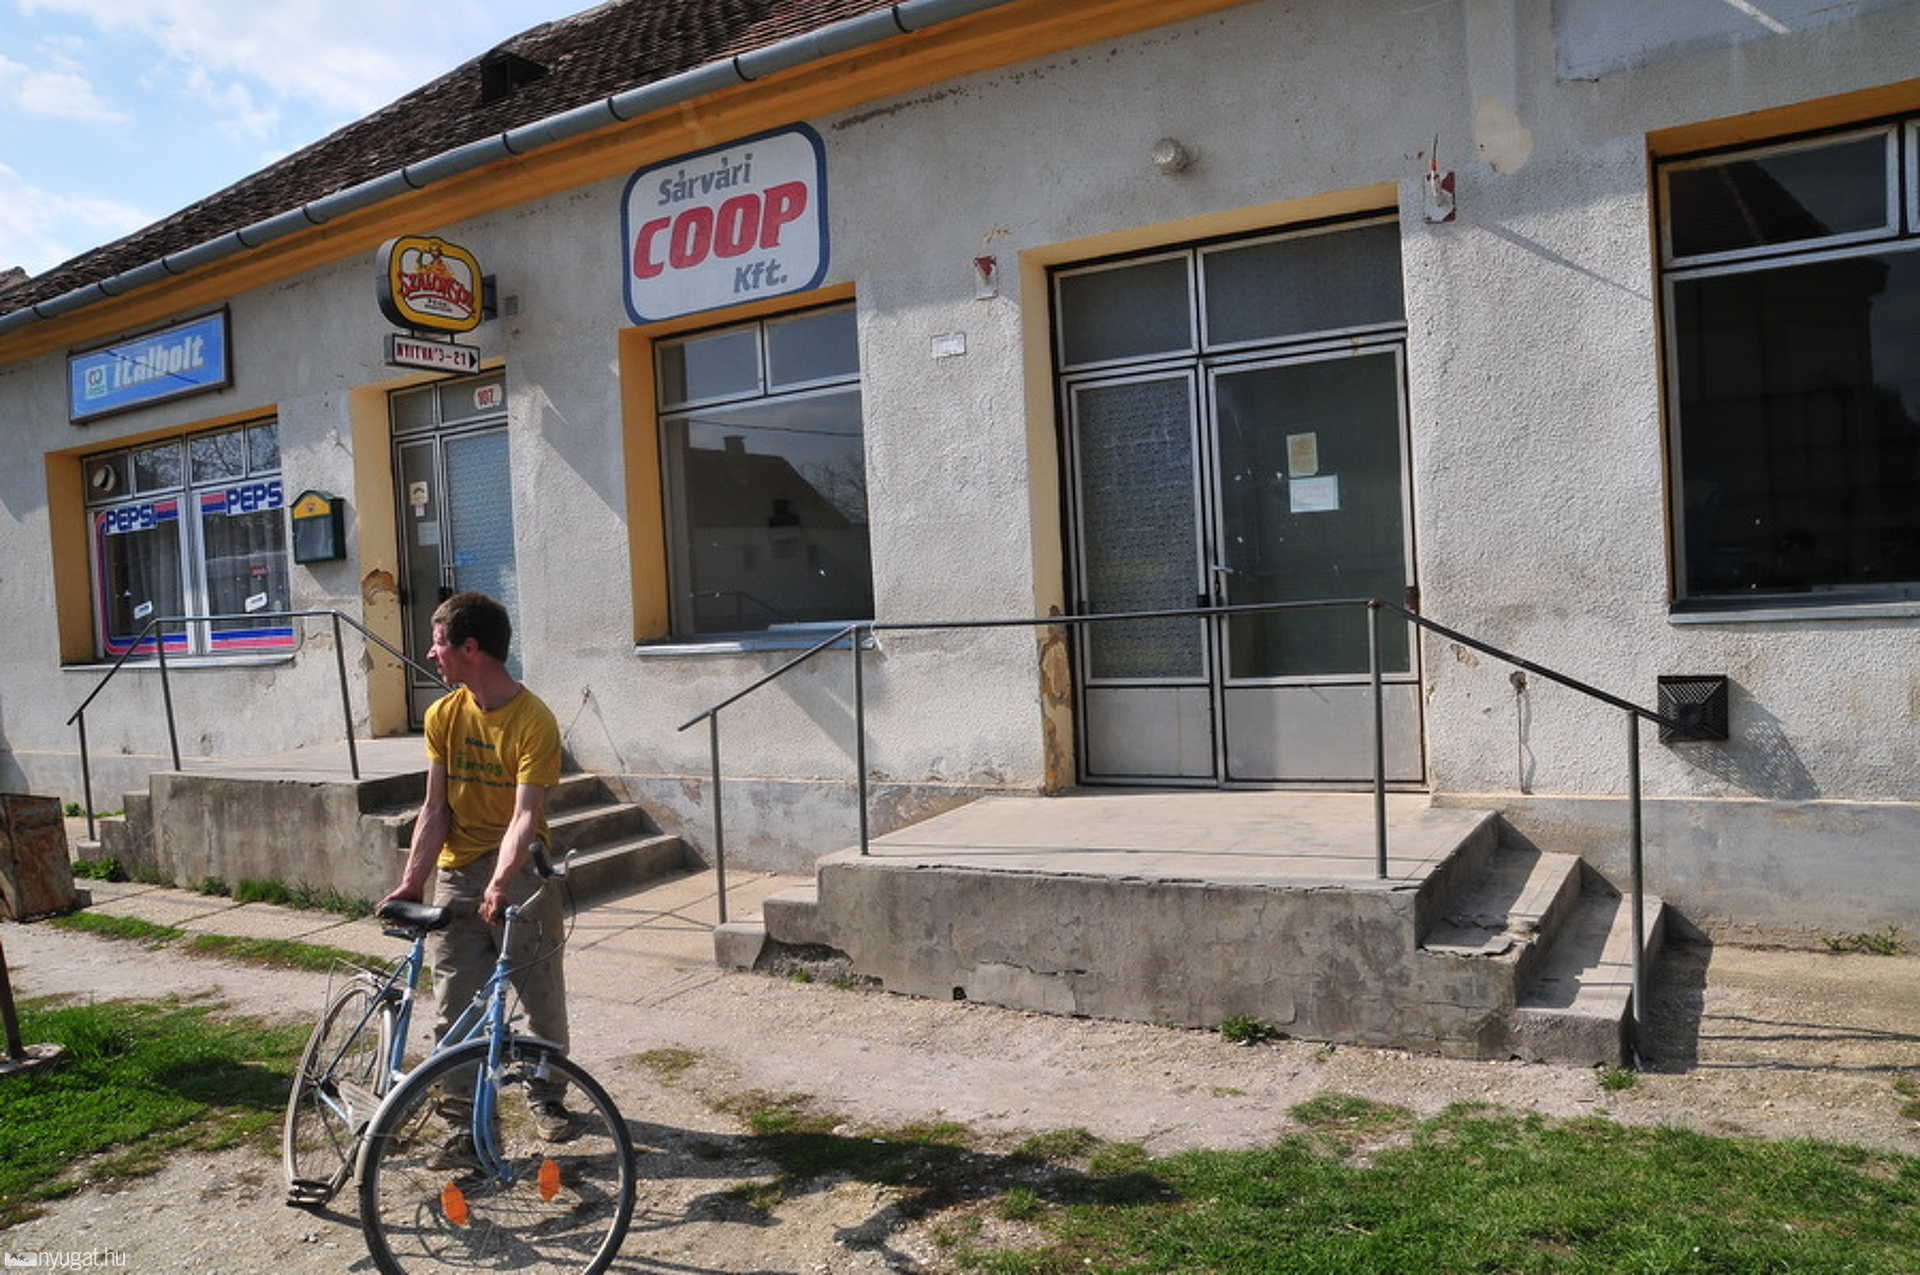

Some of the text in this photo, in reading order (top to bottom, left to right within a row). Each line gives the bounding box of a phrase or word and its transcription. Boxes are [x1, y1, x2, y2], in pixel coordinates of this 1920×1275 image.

[659, 154, 752, 205] Sárvári
[634, 181, 807, 279] COOP
[734, 259, 787, 292] Kft.
